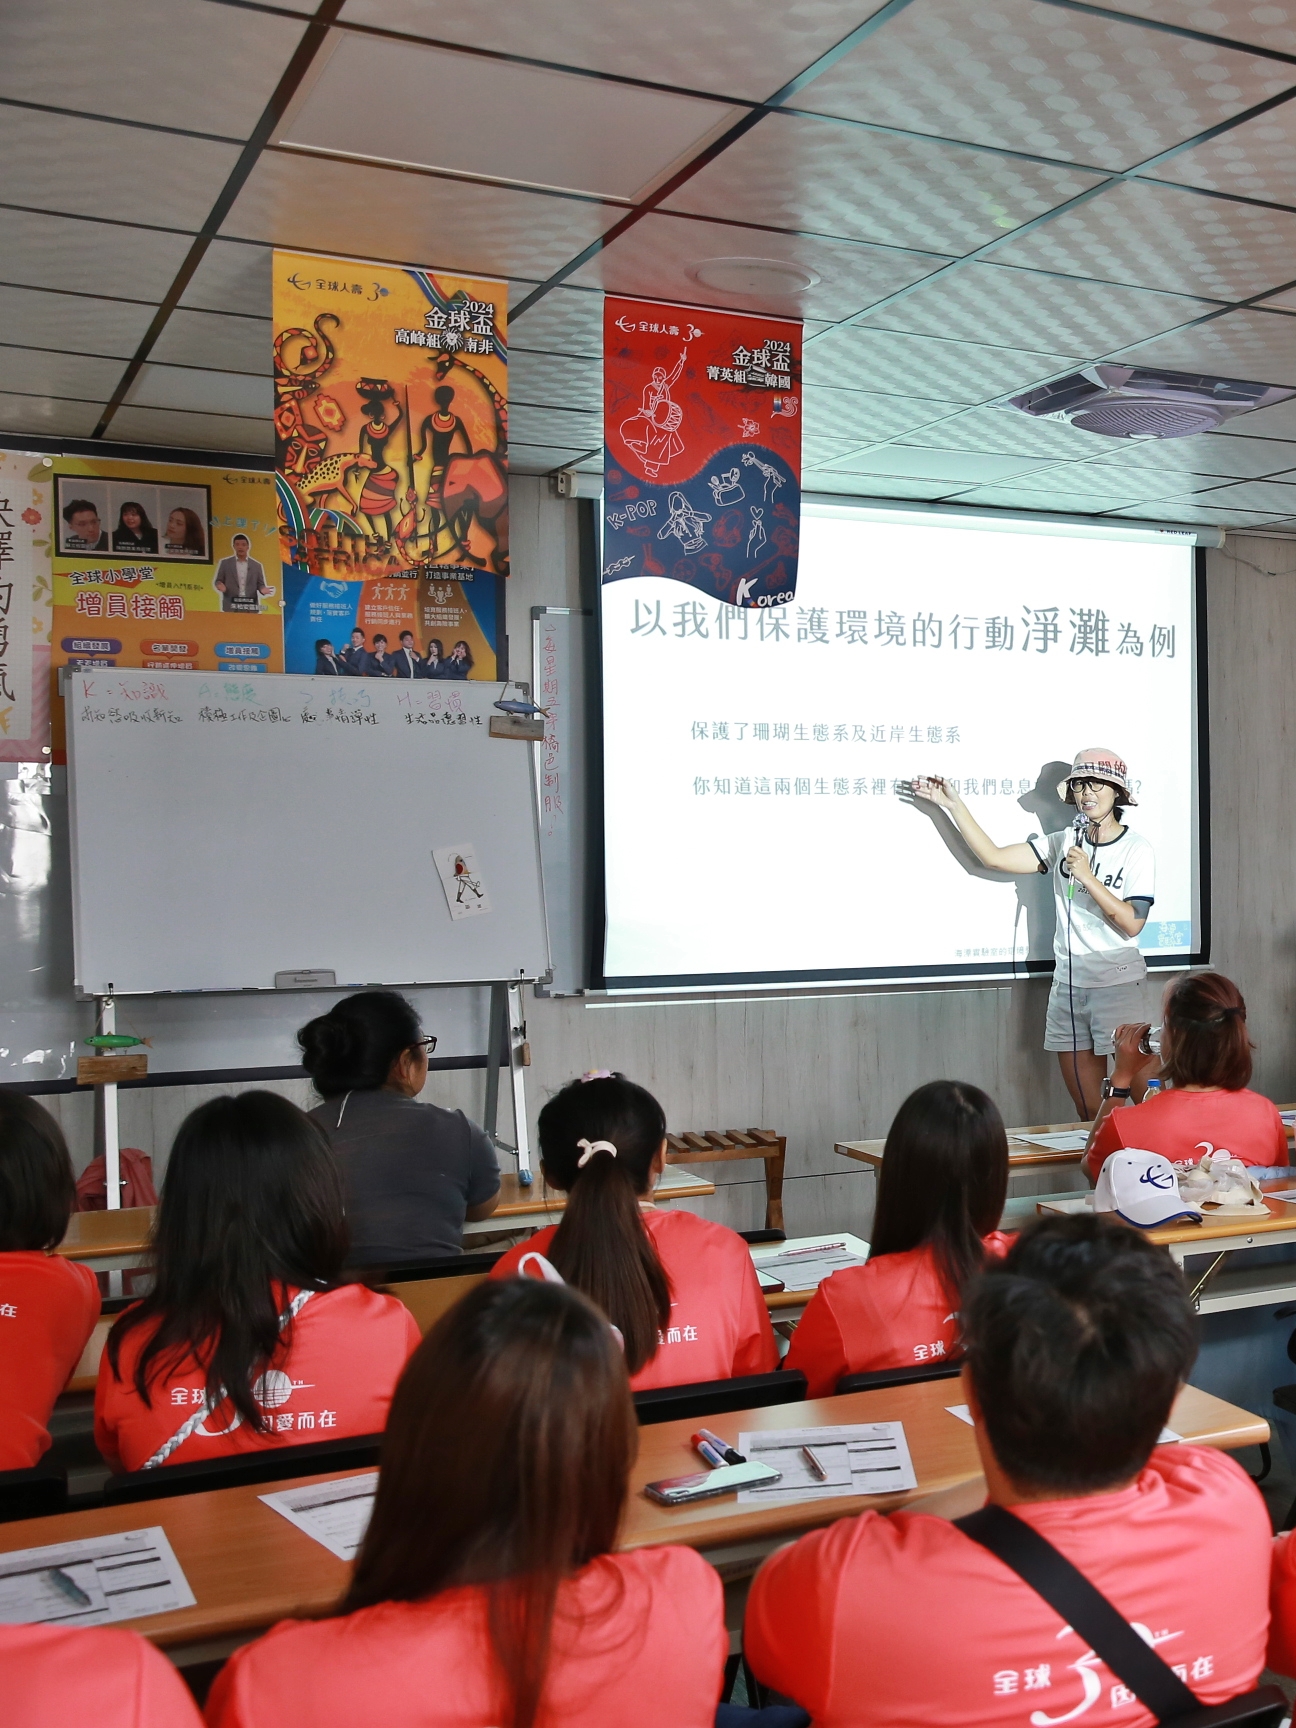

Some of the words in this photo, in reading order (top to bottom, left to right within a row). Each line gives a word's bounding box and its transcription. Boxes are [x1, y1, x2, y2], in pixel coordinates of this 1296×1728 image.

[315, 279, 363, 295] 全球人壽
[462, 300, 494, 314] 2024
[425, 307, 494, 336] 金球盃
[639, 321, 680, 336] 全球人壽
[395, 329, 441, 349] 高峰組
[464, 338, 494, 355] 南非
[764, 340, 790, 352] 2024
[732, 346, 790, 372] 金球盃
[707, 366, 747, 384] 菁英組
[764, 372, 790, 390] 韓國
[240, 476, 271, 485] 全球人壽
[606, 499, 657, 529] K-POP
[69, 567, 155, 586] 全球小學堂
[425, 572, 474, 581] 打造事業基地
[735, 577, 796, 609] Korea
[75, 592, 185, 621] 增員接觸
[690, 721, 961, 744] 保護了珊瑚生態系及近岸生態系
[913, 1341, 947, 1361] 全球
[993, 1663, 1051, 1696] 全球
